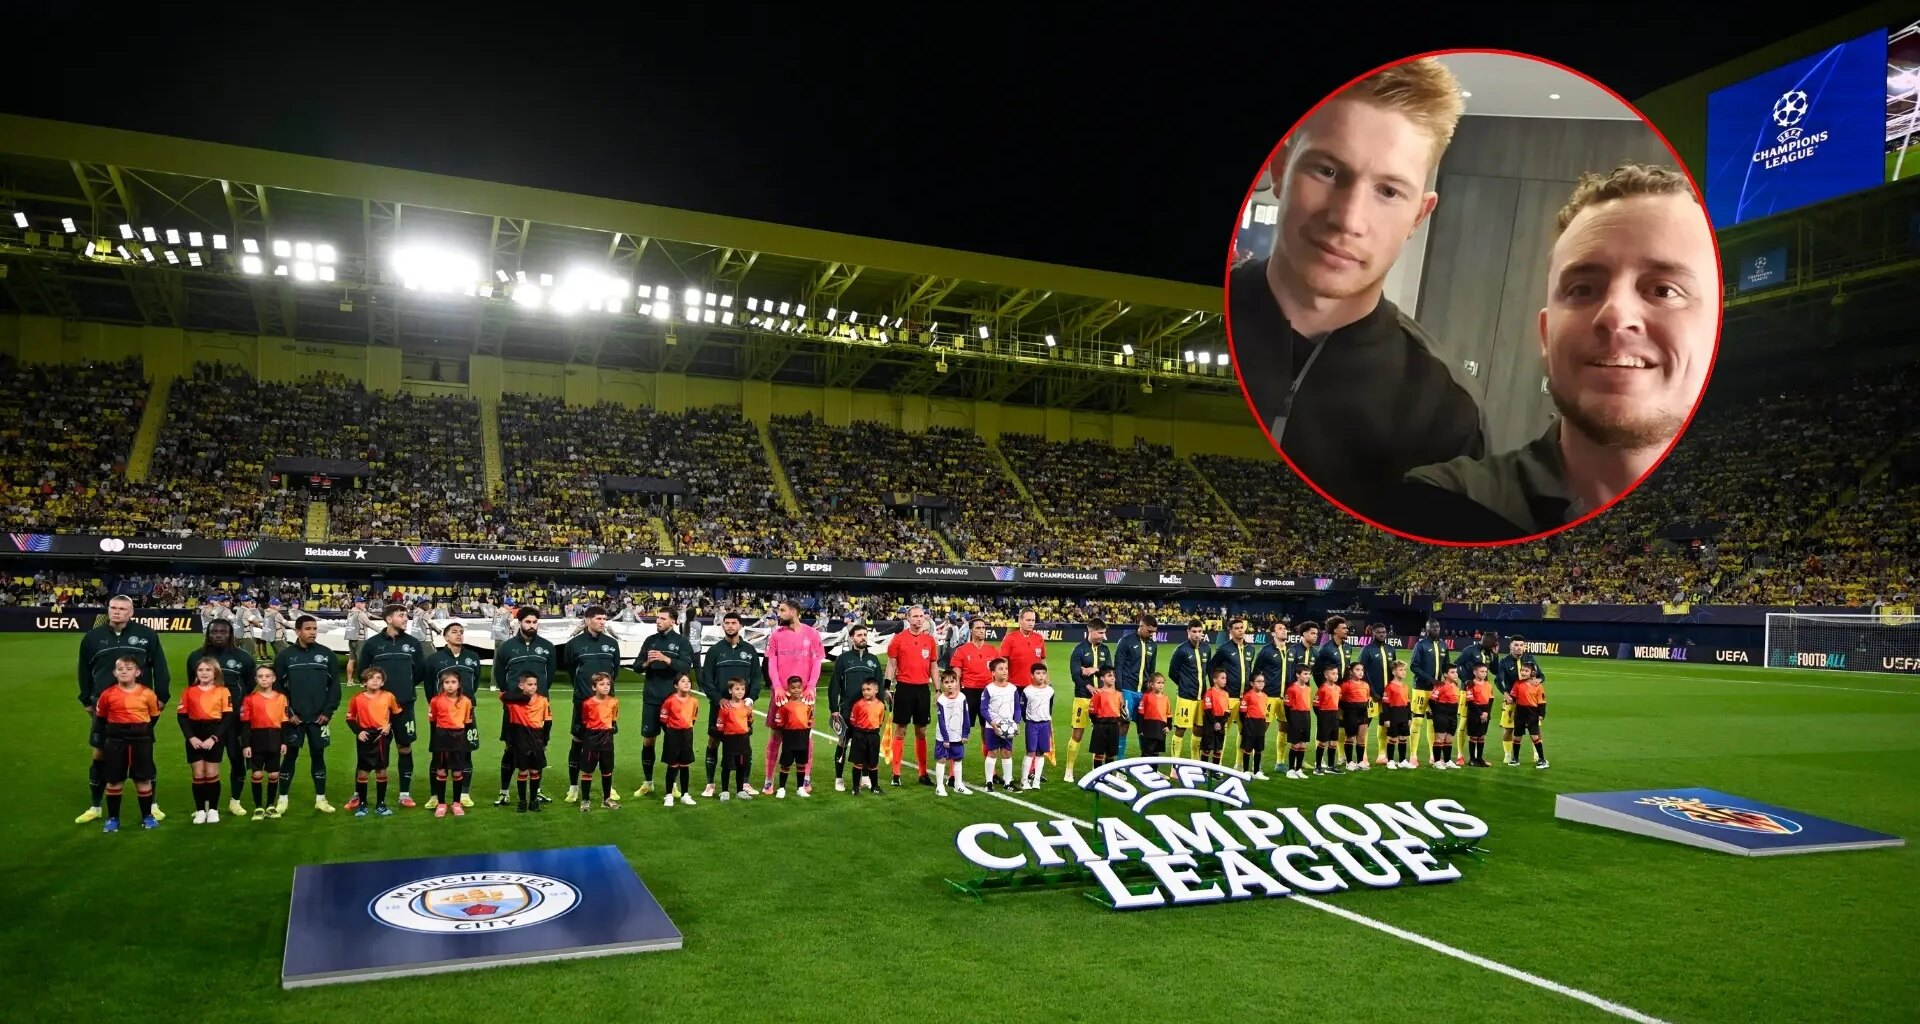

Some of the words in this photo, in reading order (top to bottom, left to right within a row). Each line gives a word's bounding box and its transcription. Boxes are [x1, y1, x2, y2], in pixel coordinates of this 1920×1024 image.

[1778, 130, 1801, 143] UEFA
[1752, 131, 1828, 162] CHAMPIONS
[1765, 147, 1814, 169] LEAGUE
[128, 542, 182, 550] mastercard
[305, 548, 351, 557] Heineken
[477, 553, 527, 562] CHAMPIONS
[528, 555, 560, 563] LEAGUE
[656, 559, 685, 567] PS5
[804, 563, 832, 572] PEPSI
[916, 566, 939, 575] QATAR
[940, 567, 968, 576] AIRWAYS
[1039, 572, 1075, 580] CHAMPIONS
[1159, 574, 1182, 584] FedEx
[1262, 579, 1295, 587] crypto.com
[36, 617, 79, 629] UEFA
[131, 617, 169, 630] COME
[170, 617, 192, 630] ALL
[985, 630, 998, 639] FA
[1050, 630, 1063, 640] ALL
[1255, 634, 1266, 643] ALL
[1582, 645, 1609, 656] UEFA
[1634, 646, 1669, 659] WELCOME
[1670, 647, 1687, 660] ALL
[1716, 650, 1748, 662] UEFA
[1789, 652, 1846, 667] #FOOTBALL
[1181, 708, 1189, 717] 14
[405, 721, 415, 733] 14
[467, 729, 479, 741] 82
[1094, 764, 1252, 805] UEFA
[956, 799, 1490, 871] CHAMPIONS
[1084, 837, 1464, 910] LEAGUE
[390, 874, 555, 899] MANCHESTER
[454, 919, 517, 930] CITY
